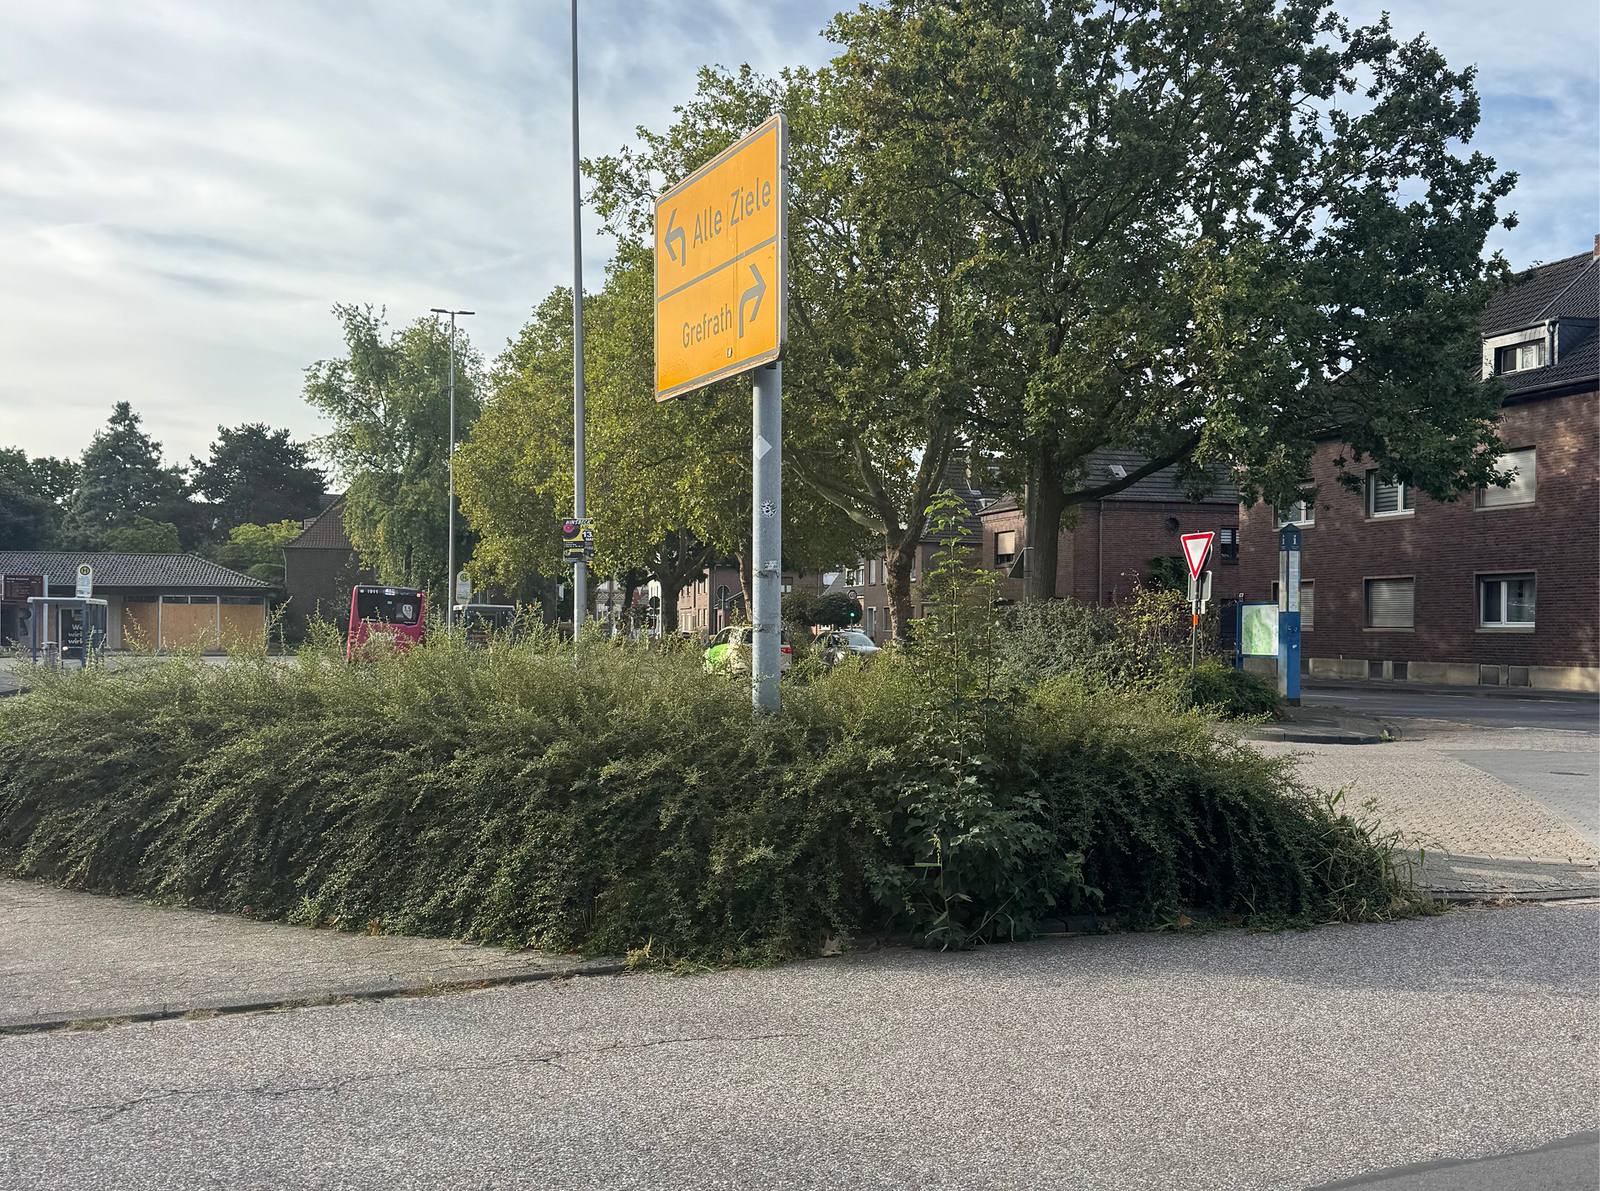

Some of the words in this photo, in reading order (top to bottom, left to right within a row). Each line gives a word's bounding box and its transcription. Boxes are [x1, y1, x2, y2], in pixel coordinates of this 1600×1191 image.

[693, 205, 722, 249] Alle
[730, 177, 772, 227] Ziele
[682, 303, 733, 349] Grefrath
